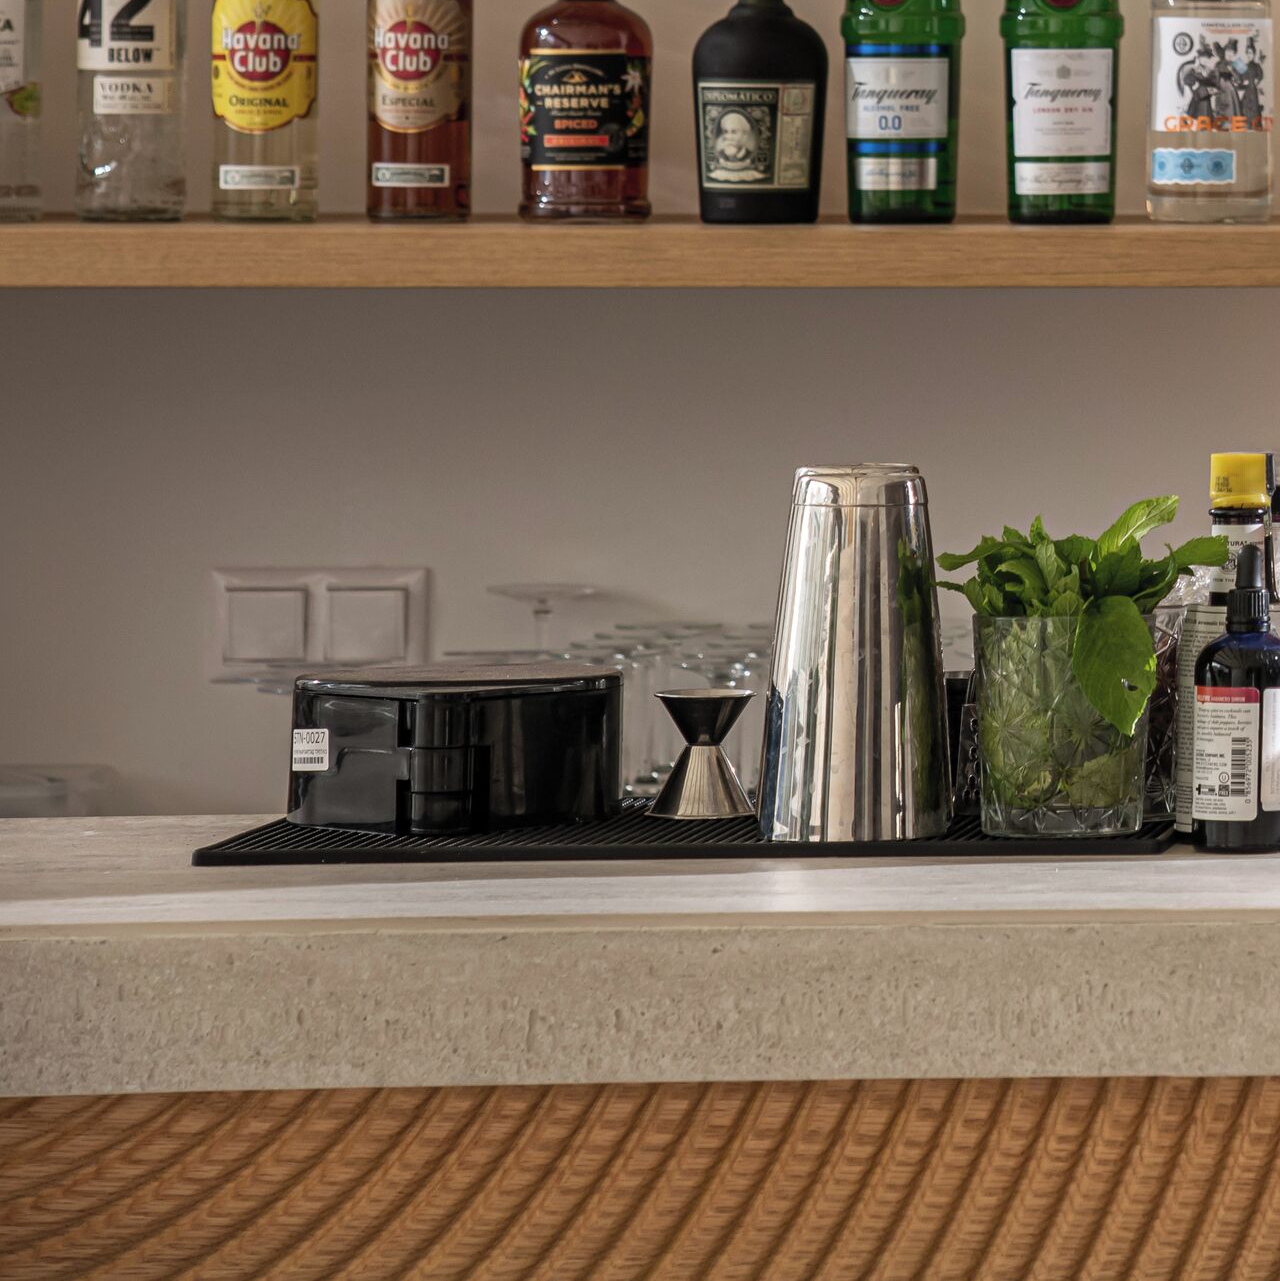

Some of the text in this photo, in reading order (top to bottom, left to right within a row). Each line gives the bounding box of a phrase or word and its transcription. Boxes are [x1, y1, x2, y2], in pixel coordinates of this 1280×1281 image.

[222, 27, 298, 50] Havana
[375, 28, 449, 50] Havana
[108, 47, 153, 63] BELOW
[232, 50, 283, 73] Club
[384, 50, 433, 73] Club
[534, 83, 622, 96] CHAIRMAN'S
[852, 81, 938, 105] Tanqueray
[1024, 82, 1102, 104] Tanqueray
[543, 97, 609, 109] RESERVE
[553, 118, 598, 131] SPICED
[878, 115, 903, 131] 0.0
[1164, 115, 1248, 134] GRACE
